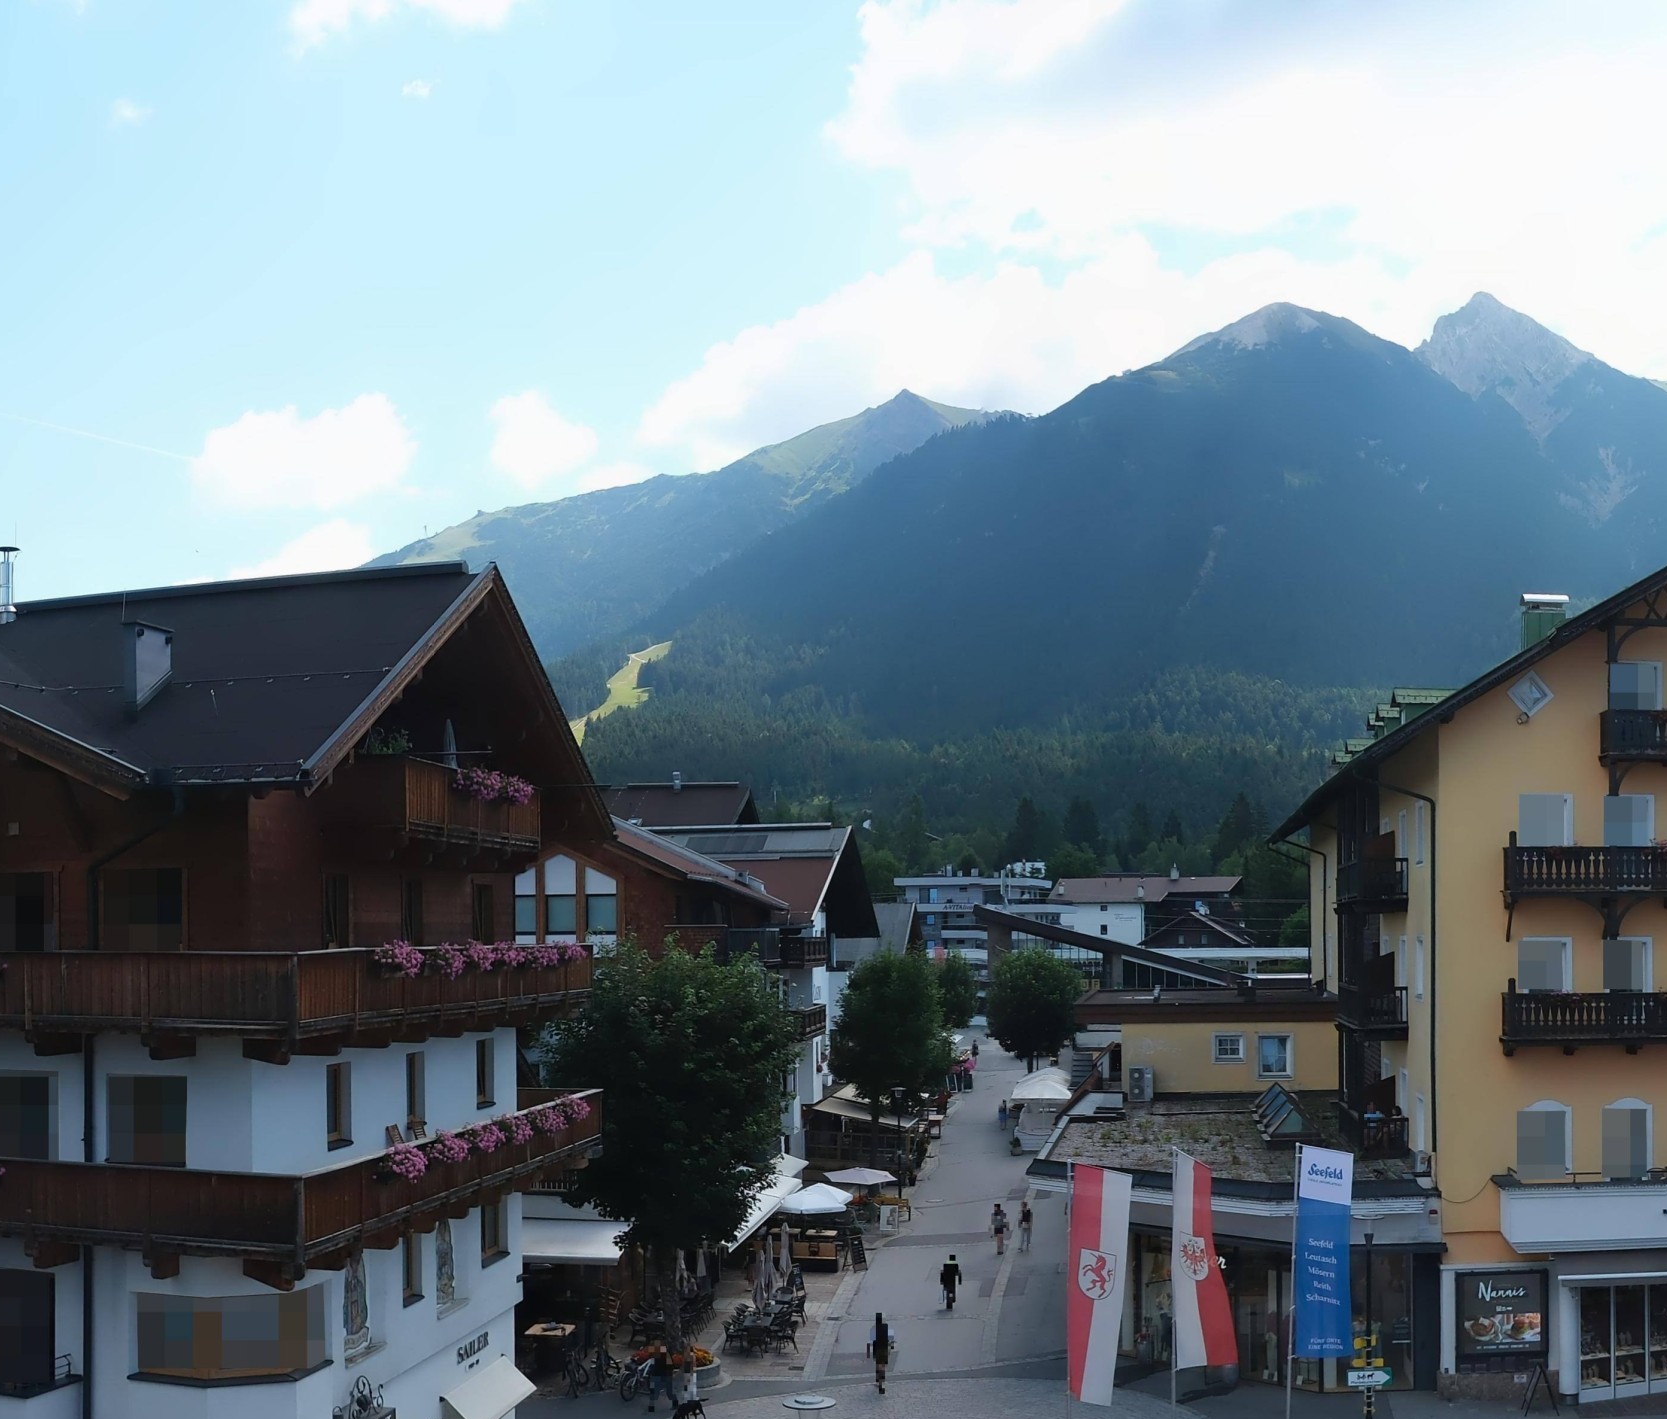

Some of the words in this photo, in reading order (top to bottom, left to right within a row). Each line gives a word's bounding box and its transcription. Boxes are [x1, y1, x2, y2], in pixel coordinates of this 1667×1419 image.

[1308, 1163, 1343, 1181] Seefeld
[1308, 1238, 1334, 1249] Seefeld
[1304, 1252, 1337, 1265] Leutasch
[1308, 1265, 1335, 1278] Mösern
[1313, 1280, 1332, 1291] Reith
[1306, 1294, 1341, 1306] Scharnitz
[457, 1331, 489, 1364] SAILER
